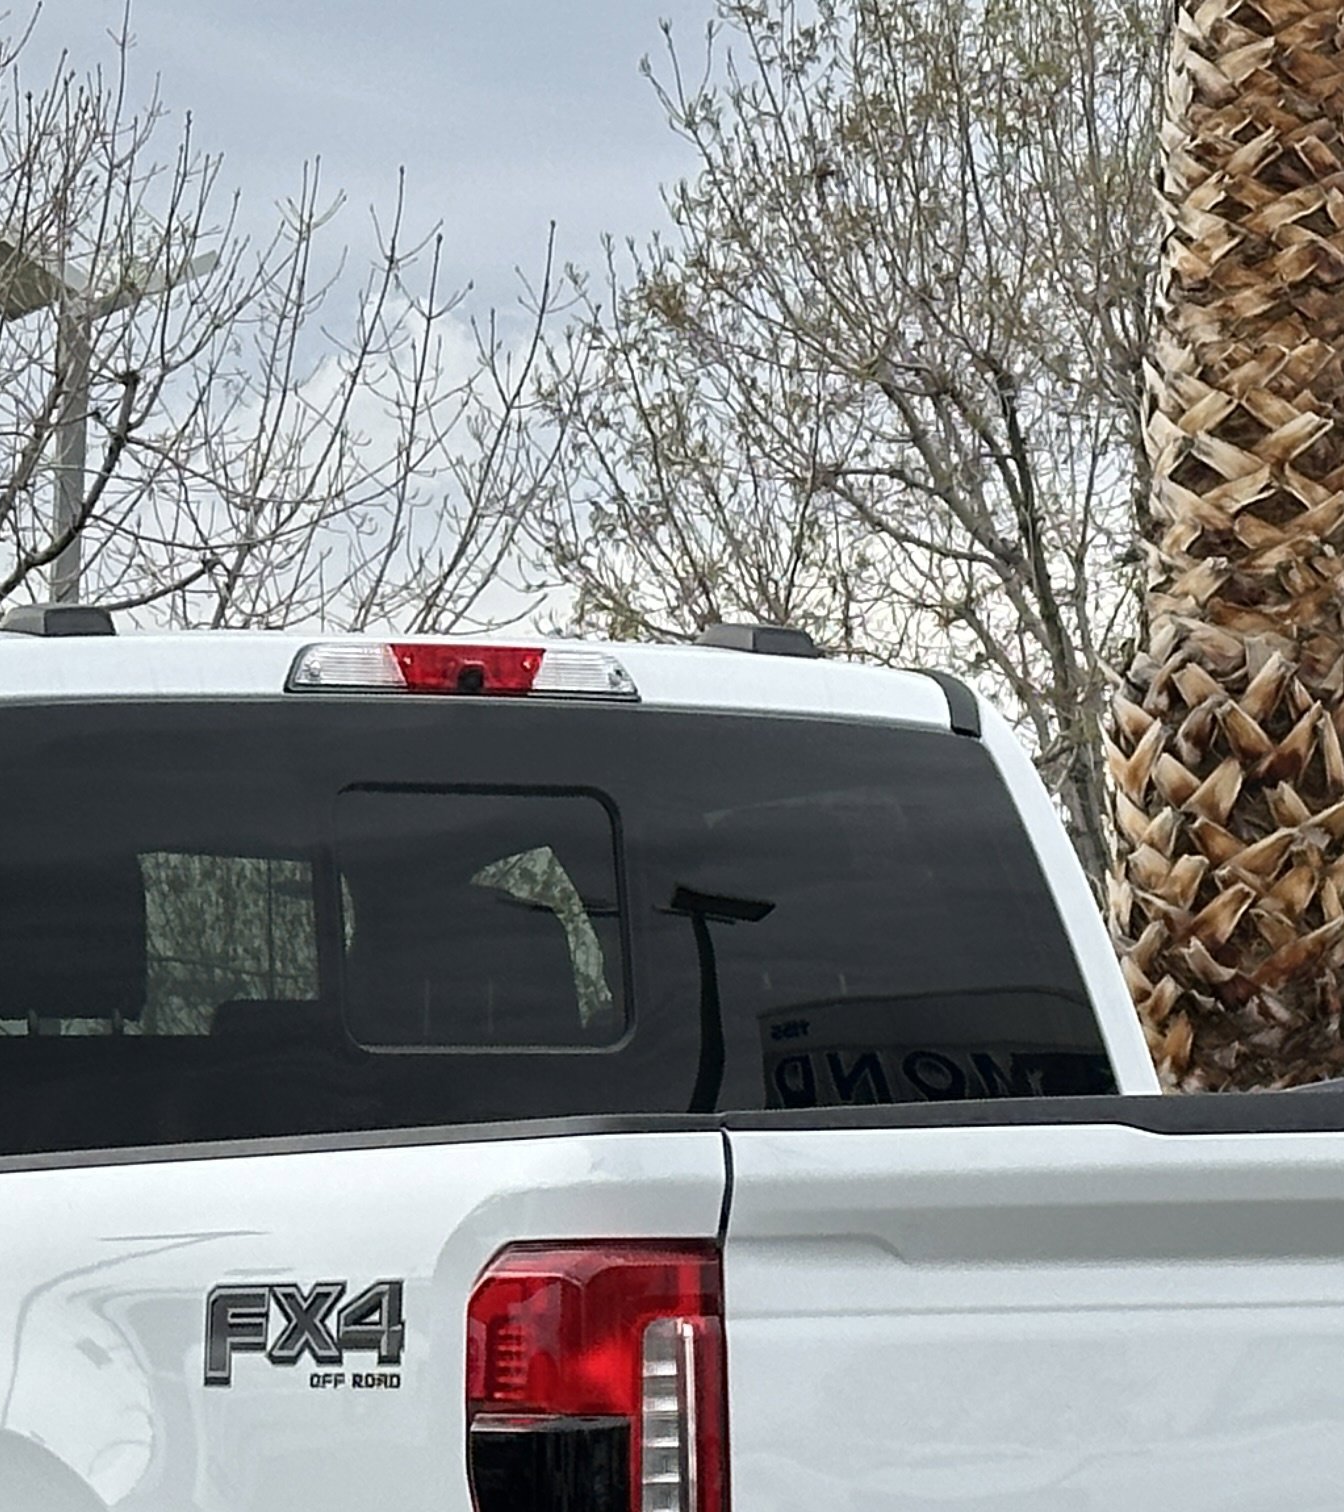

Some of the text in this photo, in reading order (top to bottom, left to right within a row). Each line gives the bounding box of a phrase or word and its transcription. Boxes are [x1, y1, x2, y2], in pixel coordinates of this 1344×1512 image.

[204, 1280, 405, 1387] FX4
[309, 1373, 401, 1389] OFF ROAD
